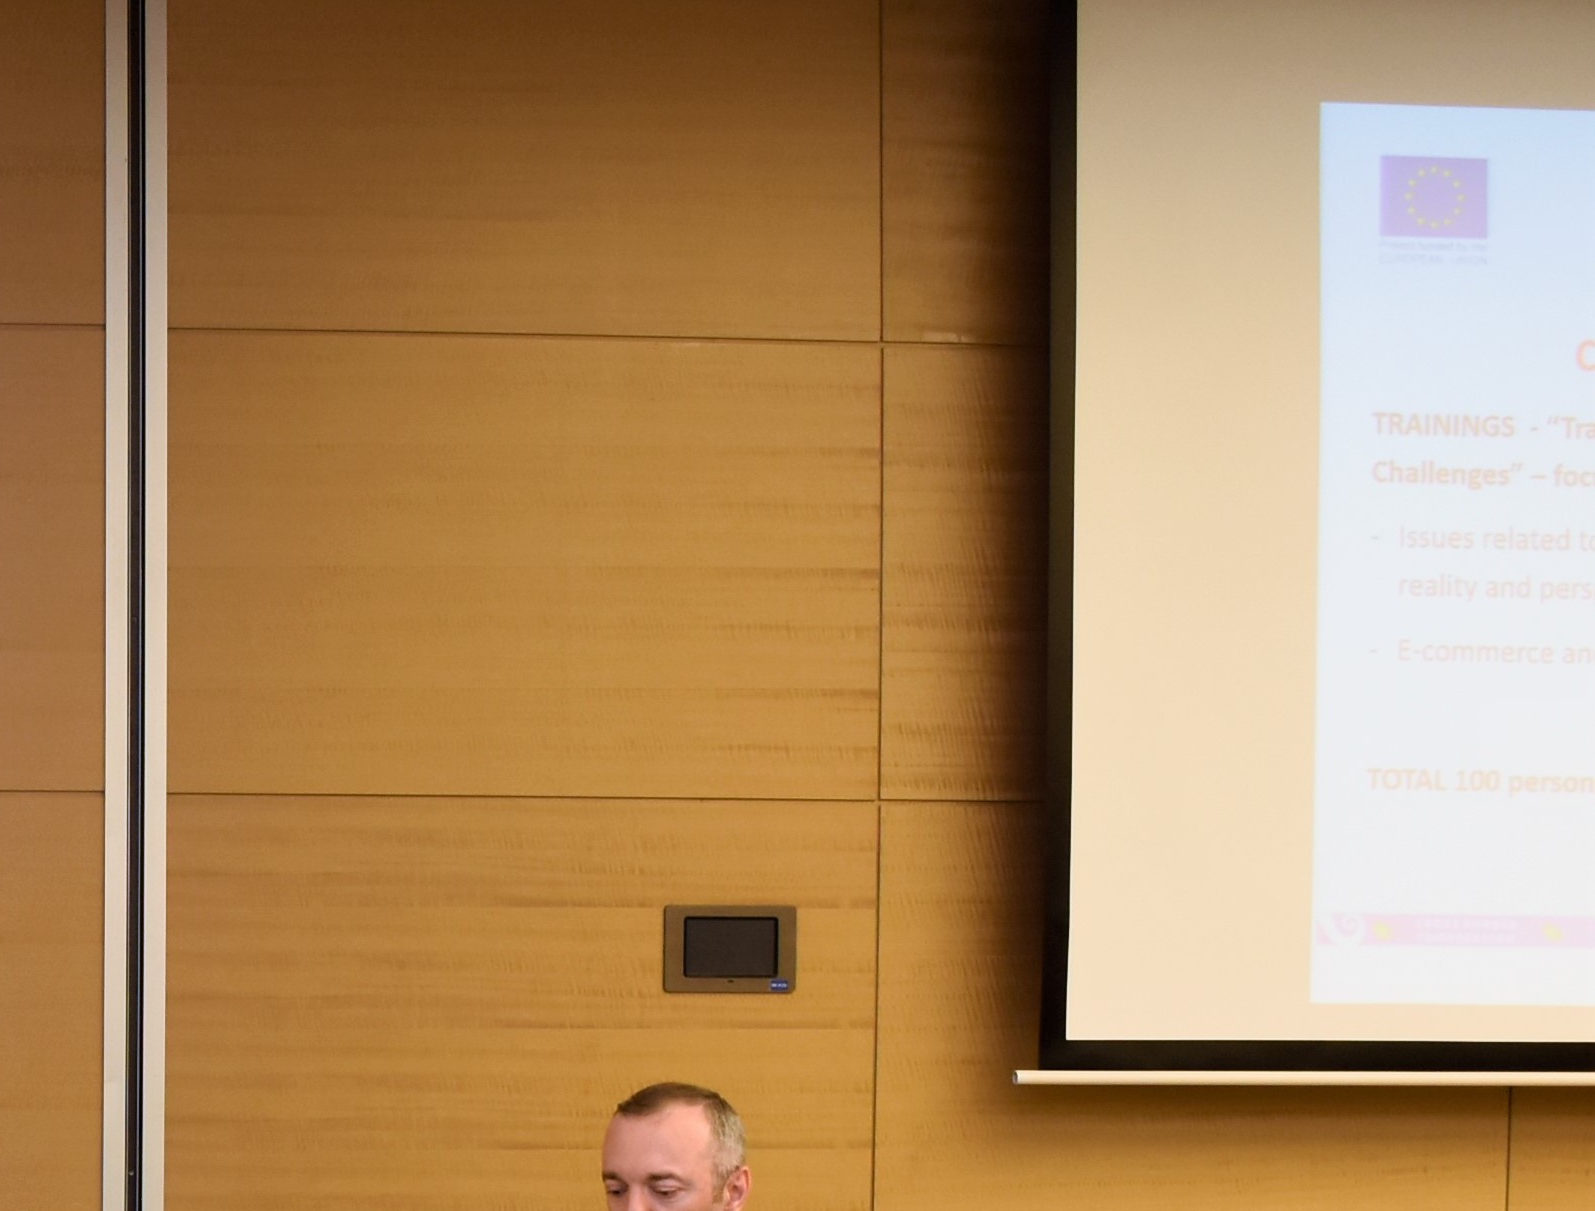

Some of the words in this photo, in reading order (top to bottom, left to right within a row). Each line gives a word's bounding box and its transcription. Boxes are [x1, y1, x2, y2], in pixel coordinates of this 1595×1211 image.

[1372, 411, 1515, 438] TRAININGS
[1553, 464, 1595, 487] foc
[1398, 525, 1475, 550] Issues
[1482, 525, 1571, 552] related
[1398, 572, 1478, 603] reality
[1485, 574, 1532, 599] and
[1540, 580, 1595, 604] pers
[1397, 638, 1554, 664] E-commerce
[1562, 646, 1595, 664] an
[1366, 768, 1447, 791] TOTAL
[1455, 769, 1500, 792] 100
